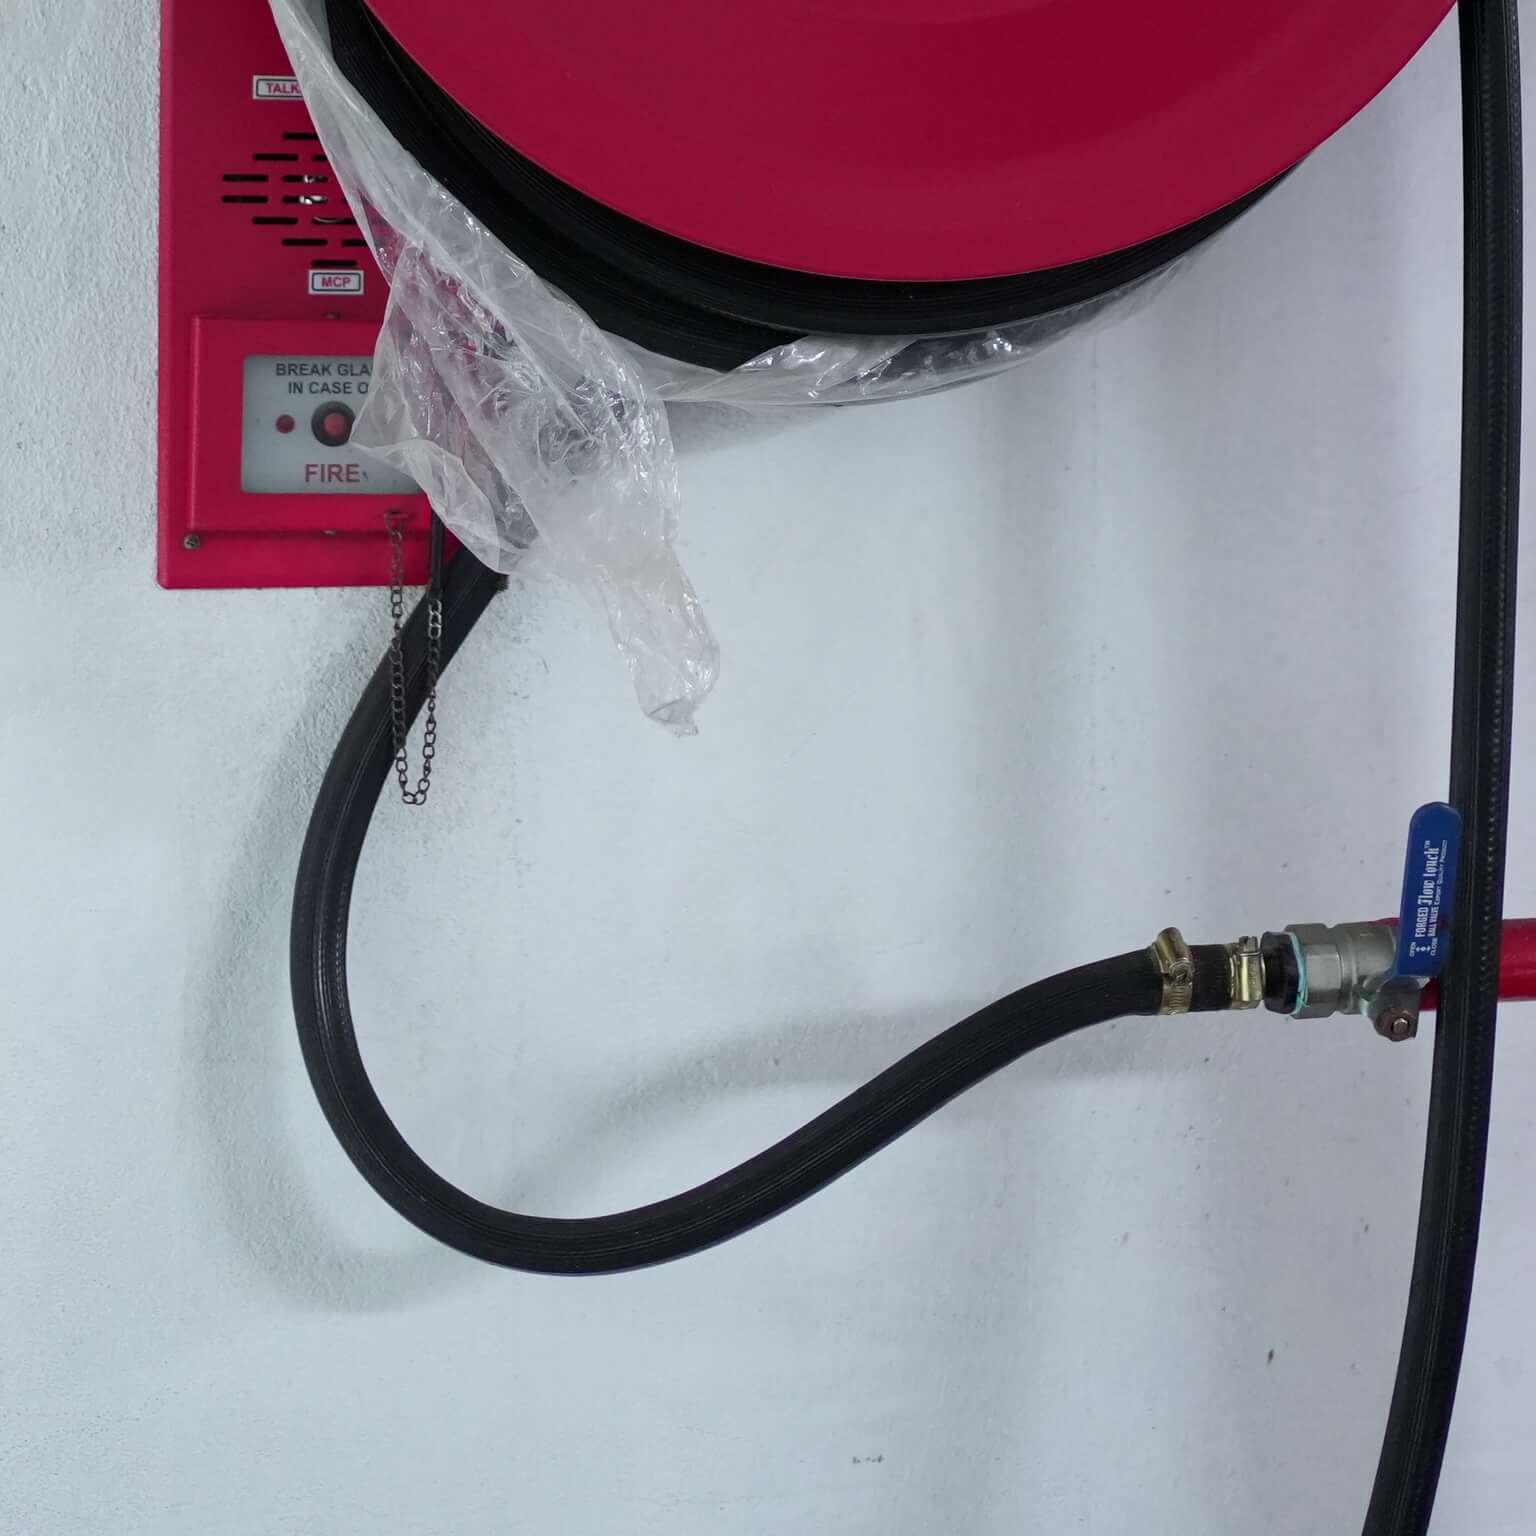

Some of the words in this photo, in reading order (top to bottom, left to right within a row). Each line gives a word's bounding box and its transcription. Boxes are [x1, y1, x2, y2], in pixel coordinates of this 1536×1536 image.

[321, 276, 352, 289] MCP
[275, 363, 333, 377] BREAK
[337, 363, 373, 377] GLA
[287, 382, 303, 395] IN
[308, 381, 352, 395] CASE
[304, 463, 361, 483] FIRE
[1429, 906, 1440, 923] VALVE
[1415, 907, 1429, 938] FORGED
